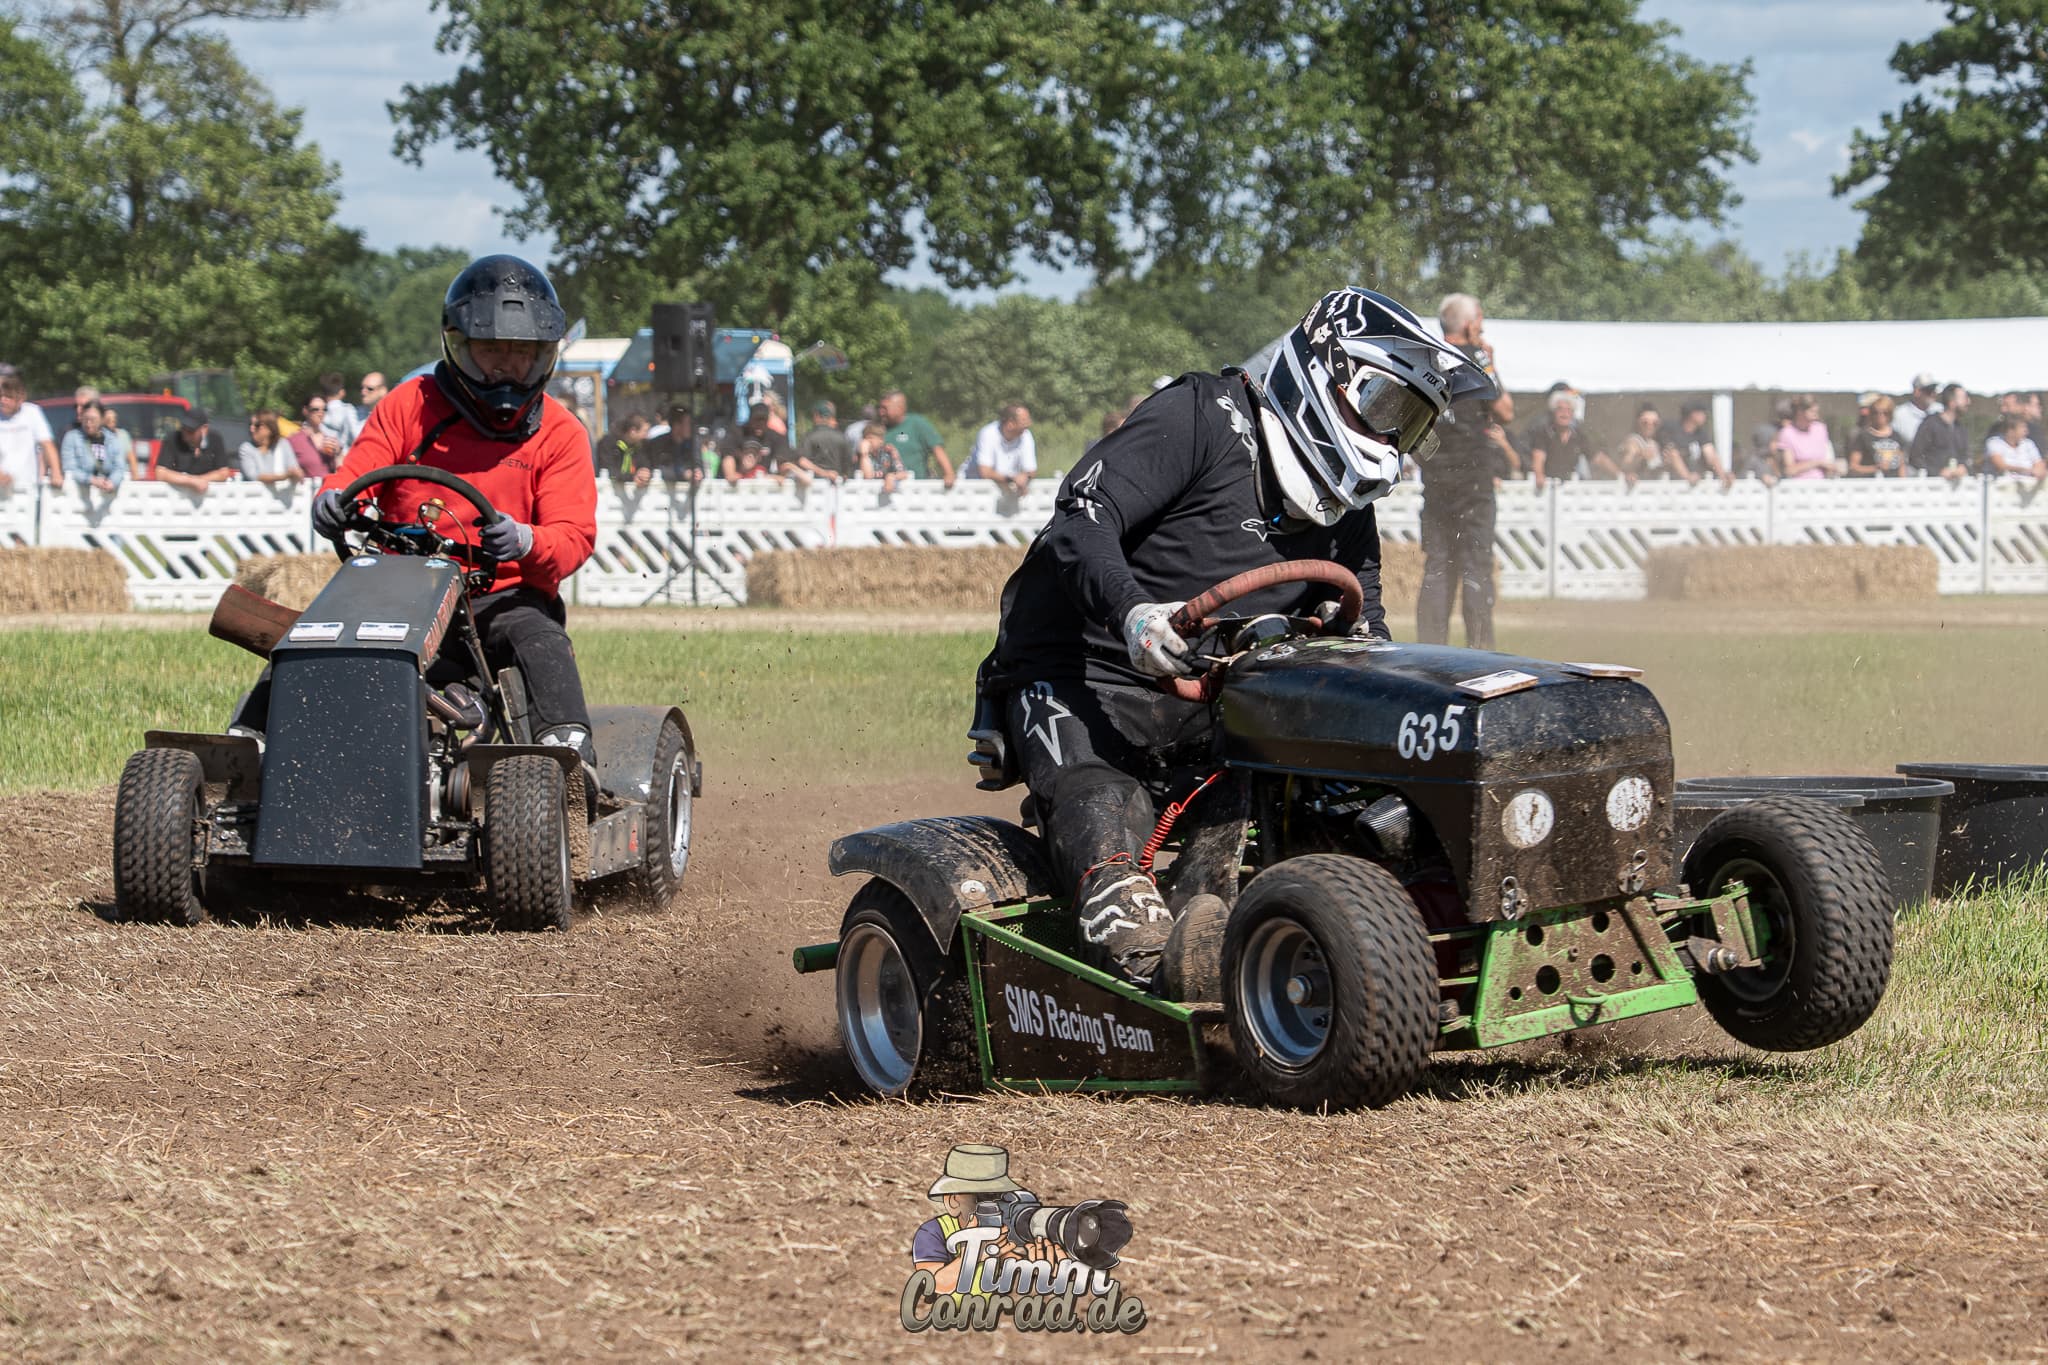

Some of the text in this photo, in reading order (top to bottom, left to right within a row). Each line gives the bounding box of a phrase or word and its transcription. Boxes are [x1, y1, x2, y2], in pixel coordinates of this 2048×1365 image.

[1398, 704, 1466, 761] 635
[1005, 983, 1154, 1055] SMS Racing Team
